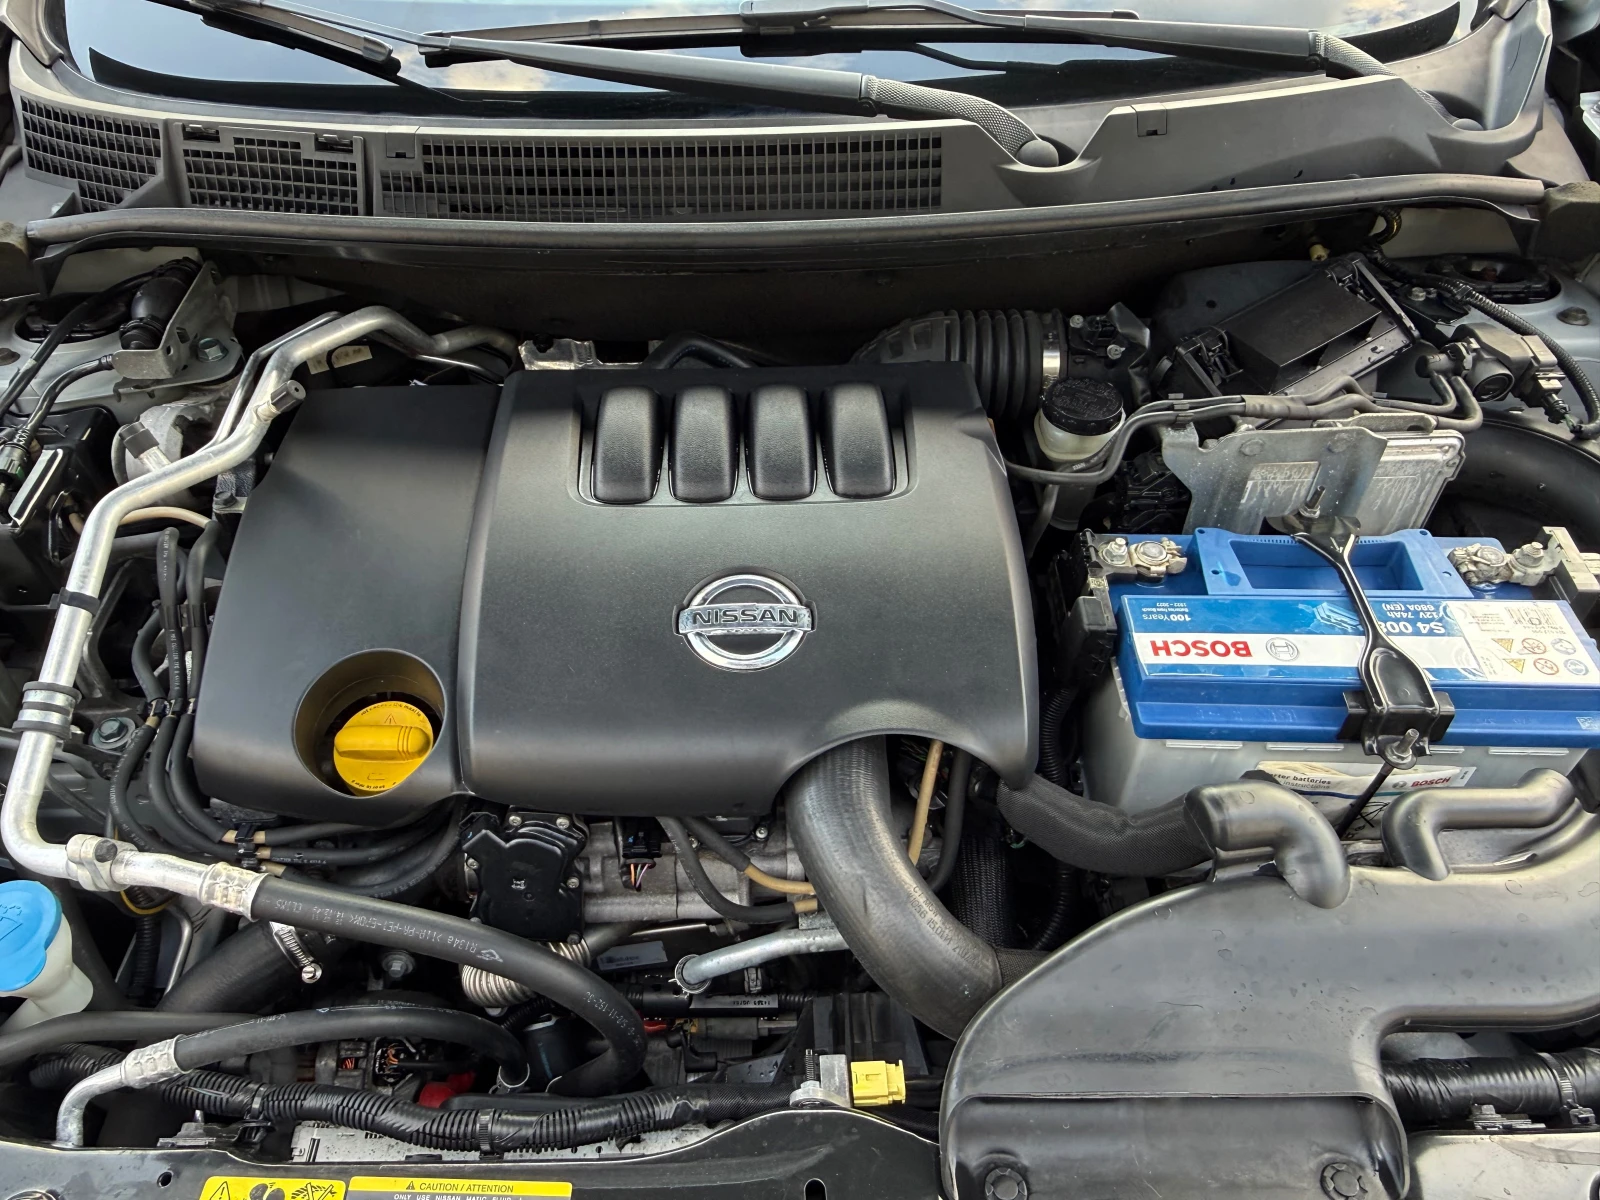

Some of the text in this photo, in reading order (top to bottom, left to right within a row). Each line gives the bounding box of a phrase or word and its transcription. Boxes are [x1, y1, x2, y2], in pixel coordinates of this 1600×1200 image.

[1381, 603, 1404, 611] (EN)
[692, 609, 798, 625] NISSAN
[1142, 613, 1192, 622] 100 Years
[1386, 611, 1415, 619] 74Ah
[1416, 621, 1446, 634] S4
[1149, 640, 1253, 658] BOSCH
[1293, 775, 1332, 785] batteries
[1410, 776, 1452, 788] BOSCH
[447, 935, 479, 953] R134a
[419, 1182, 459, 1192] CAUTION
[465, 1183, 514, 1193] ATTENTION
